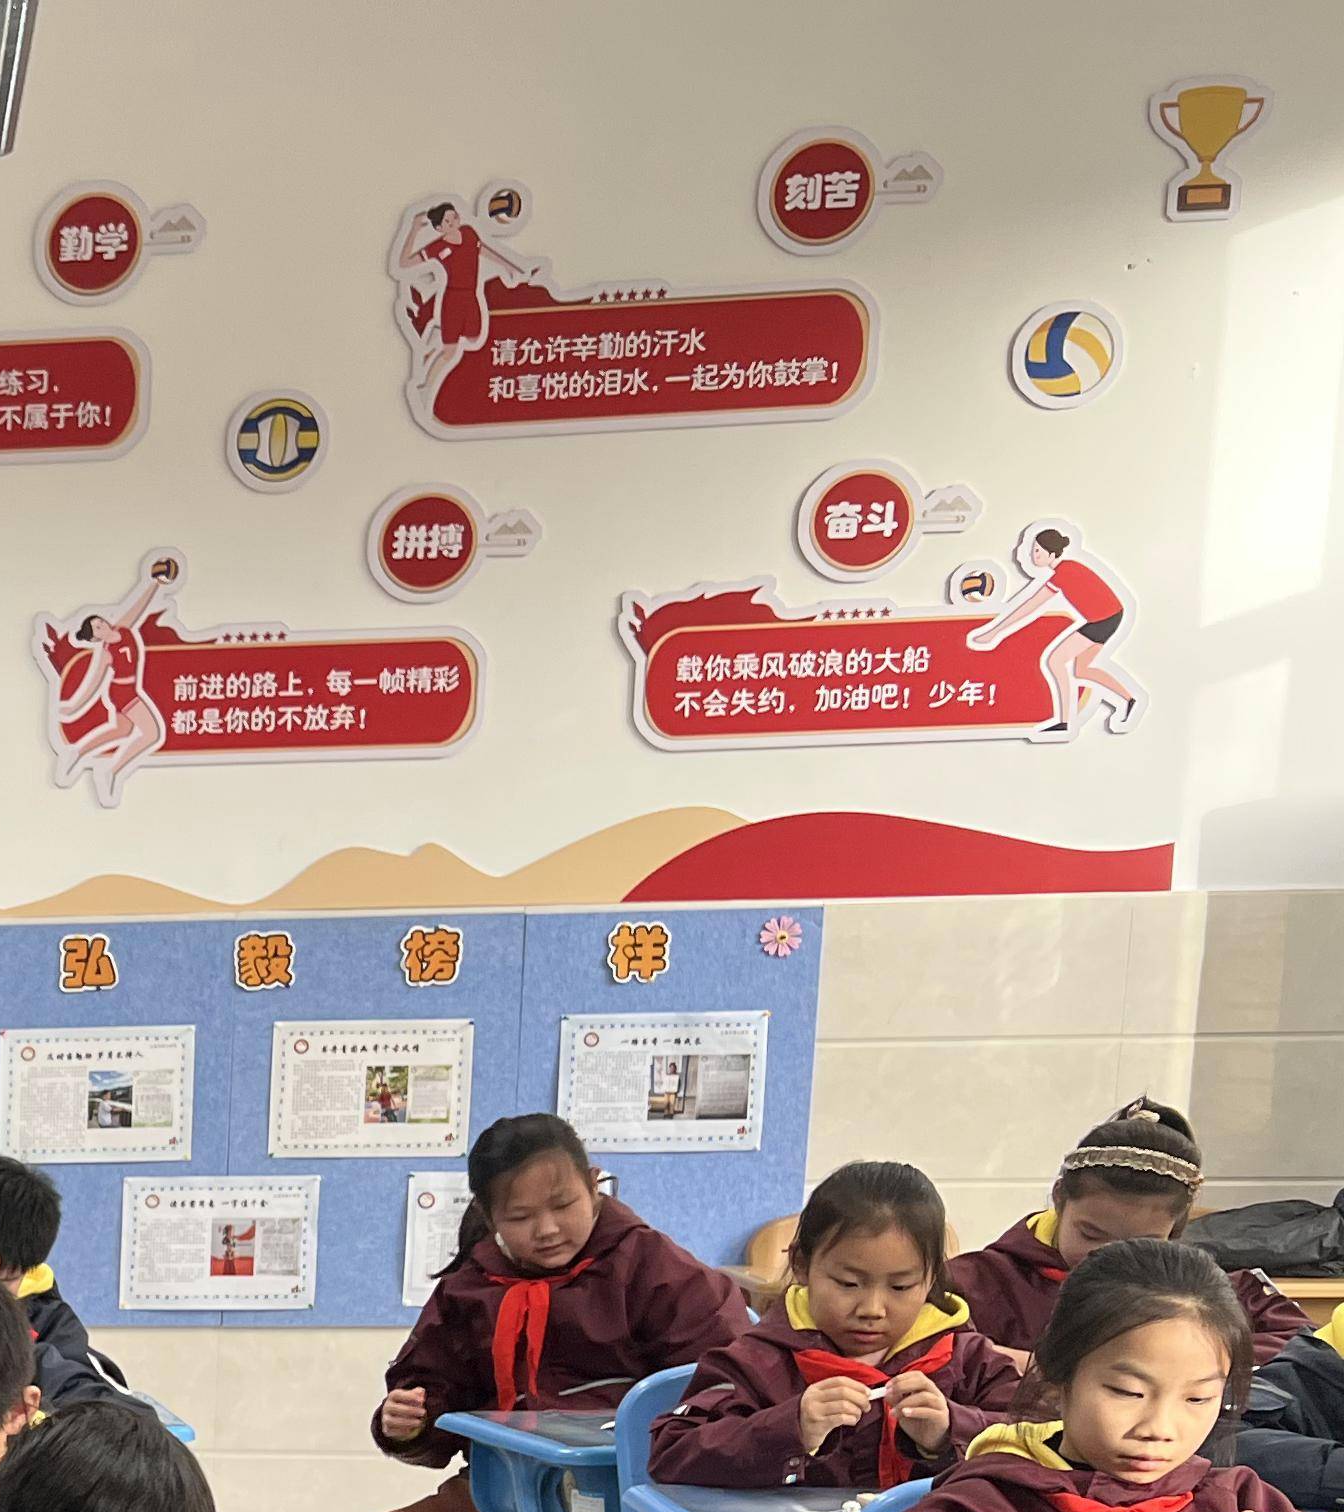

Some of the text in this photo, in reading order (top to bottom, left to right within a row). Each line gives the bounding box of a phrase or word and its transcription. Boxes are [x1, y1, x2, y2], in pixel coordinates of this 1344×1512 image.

[784, 170, 861, 212] 刻苦
[58, 222, 129, 263] 勤学
[489, 327, 707, 367] 请允许辛勤的汗水
[824, 501, 899, 540] 奋斗
[391, 523, 464, 560] 拼搏
[676, 645, 932, 682] 载你乘风破浪的大船
[171, 704, 366, 735] 都是你的不放弃！
